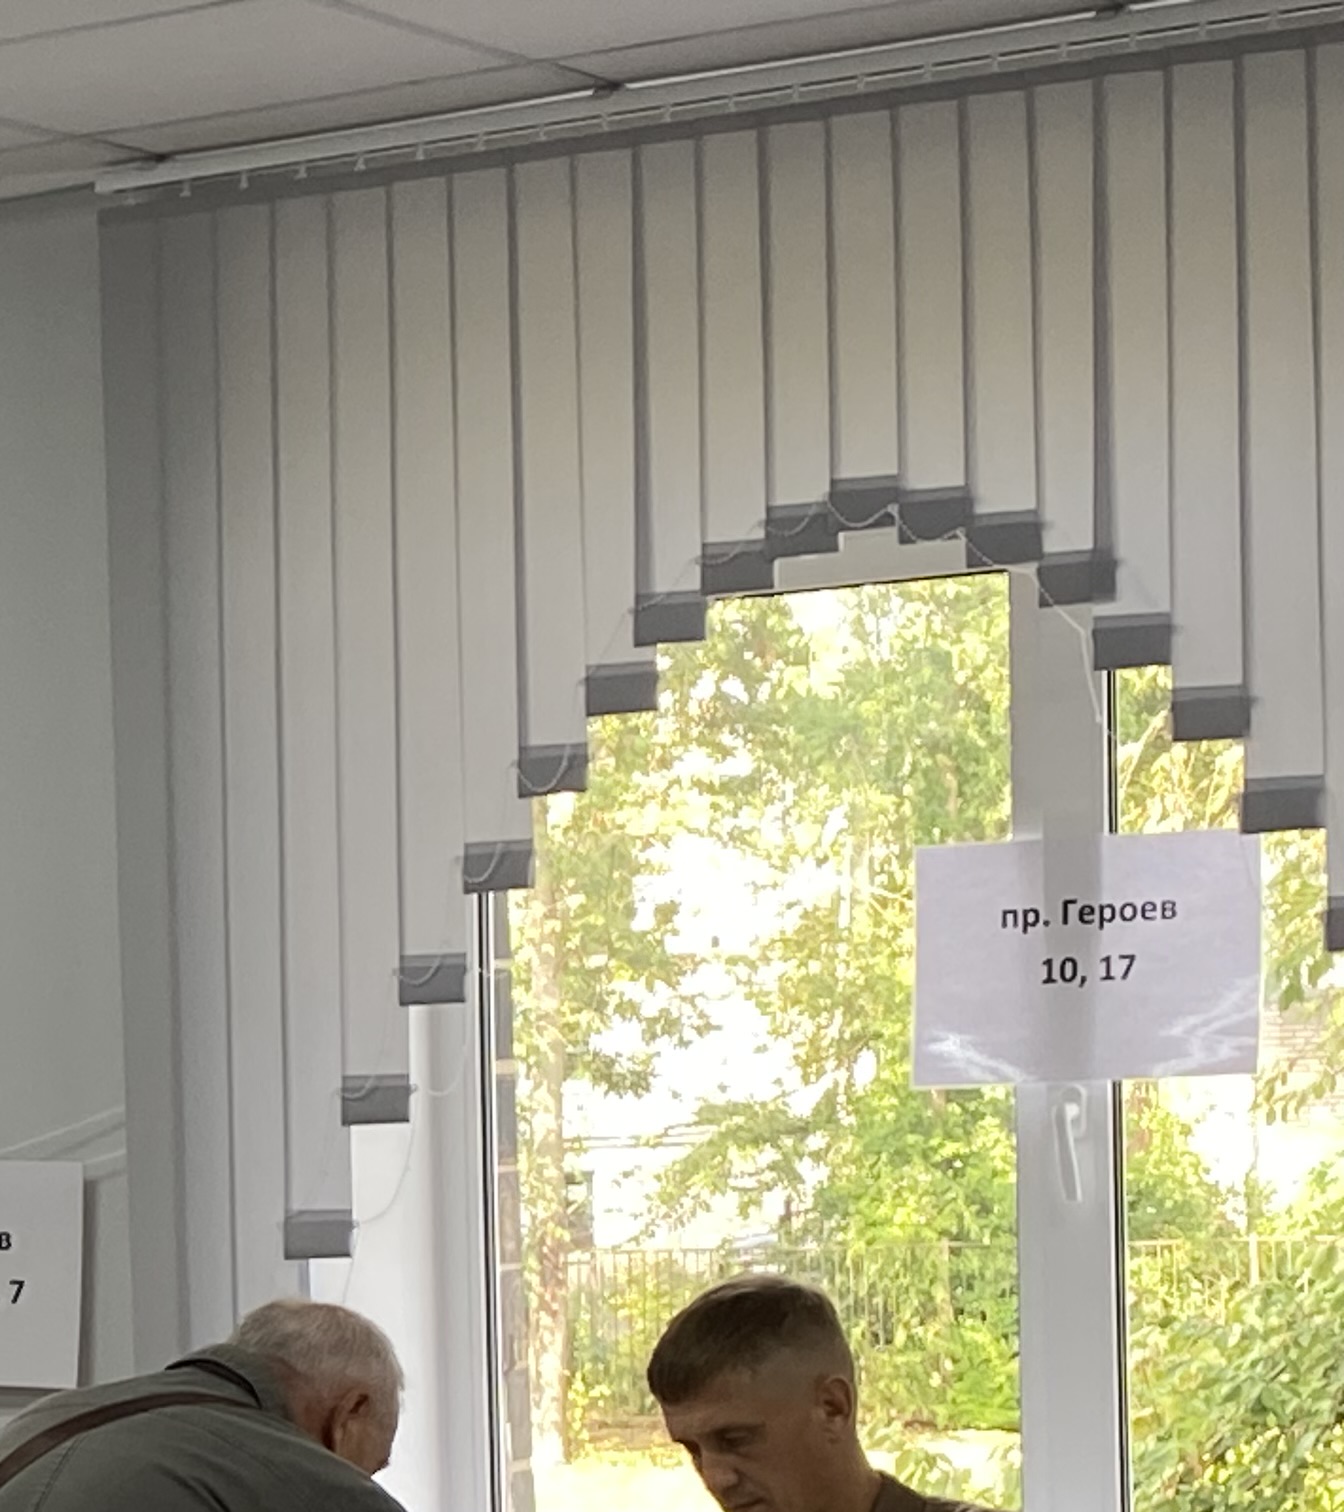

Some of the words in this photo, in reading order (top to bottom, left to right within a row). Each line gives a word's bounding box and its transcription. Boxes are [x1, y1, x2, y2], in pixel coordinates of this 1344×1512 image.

[1001, 908, 1051, 933] пр.
[1061, 898, 1177, 930] Героев
[1041, 956, 1087, 988] 10,
[1099, 954, 1136, 981] 17
[9, 1280, 25, 1304] 7
